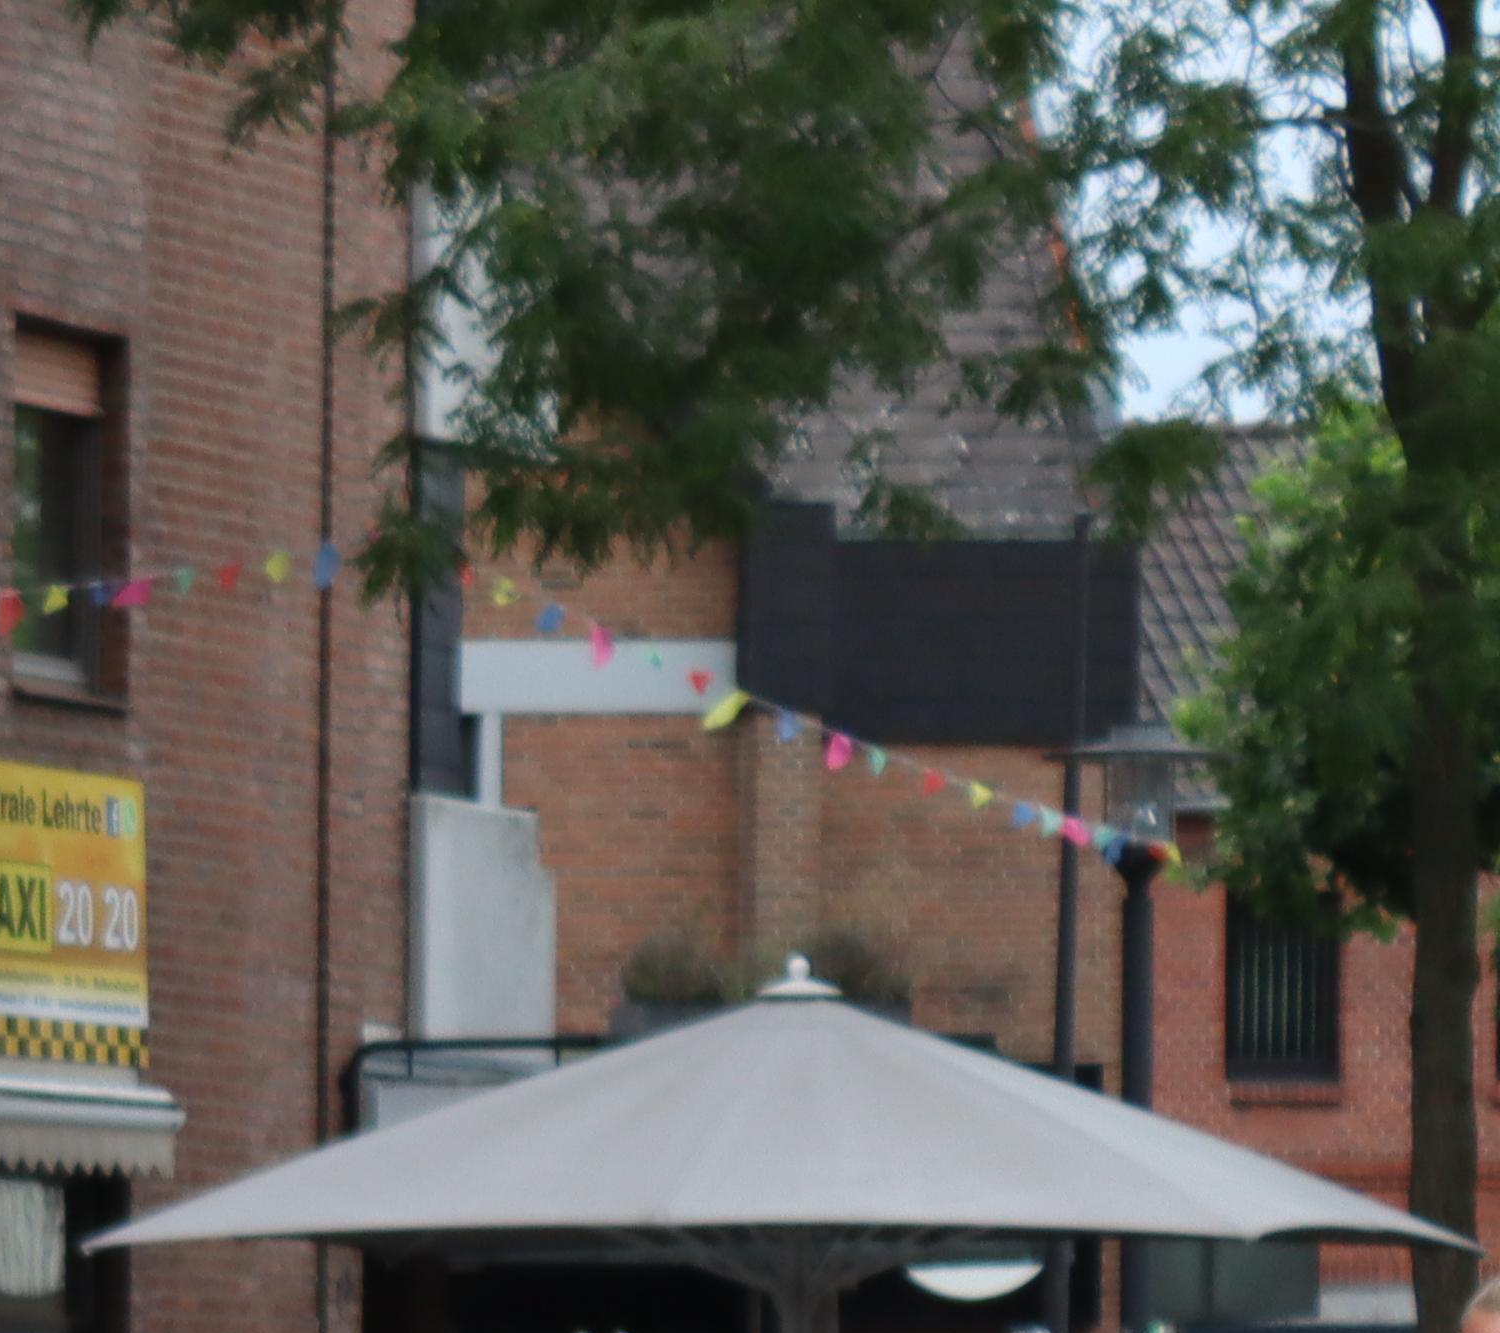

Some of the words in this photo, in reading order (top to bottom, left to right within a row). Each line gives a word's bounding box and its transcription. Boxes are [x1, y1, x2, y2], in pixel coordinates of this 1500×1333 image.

[41, 788, 101, 835] Lehrte
[57, 878, 95, 948] 20
[103, 884, 140, 953] 20
